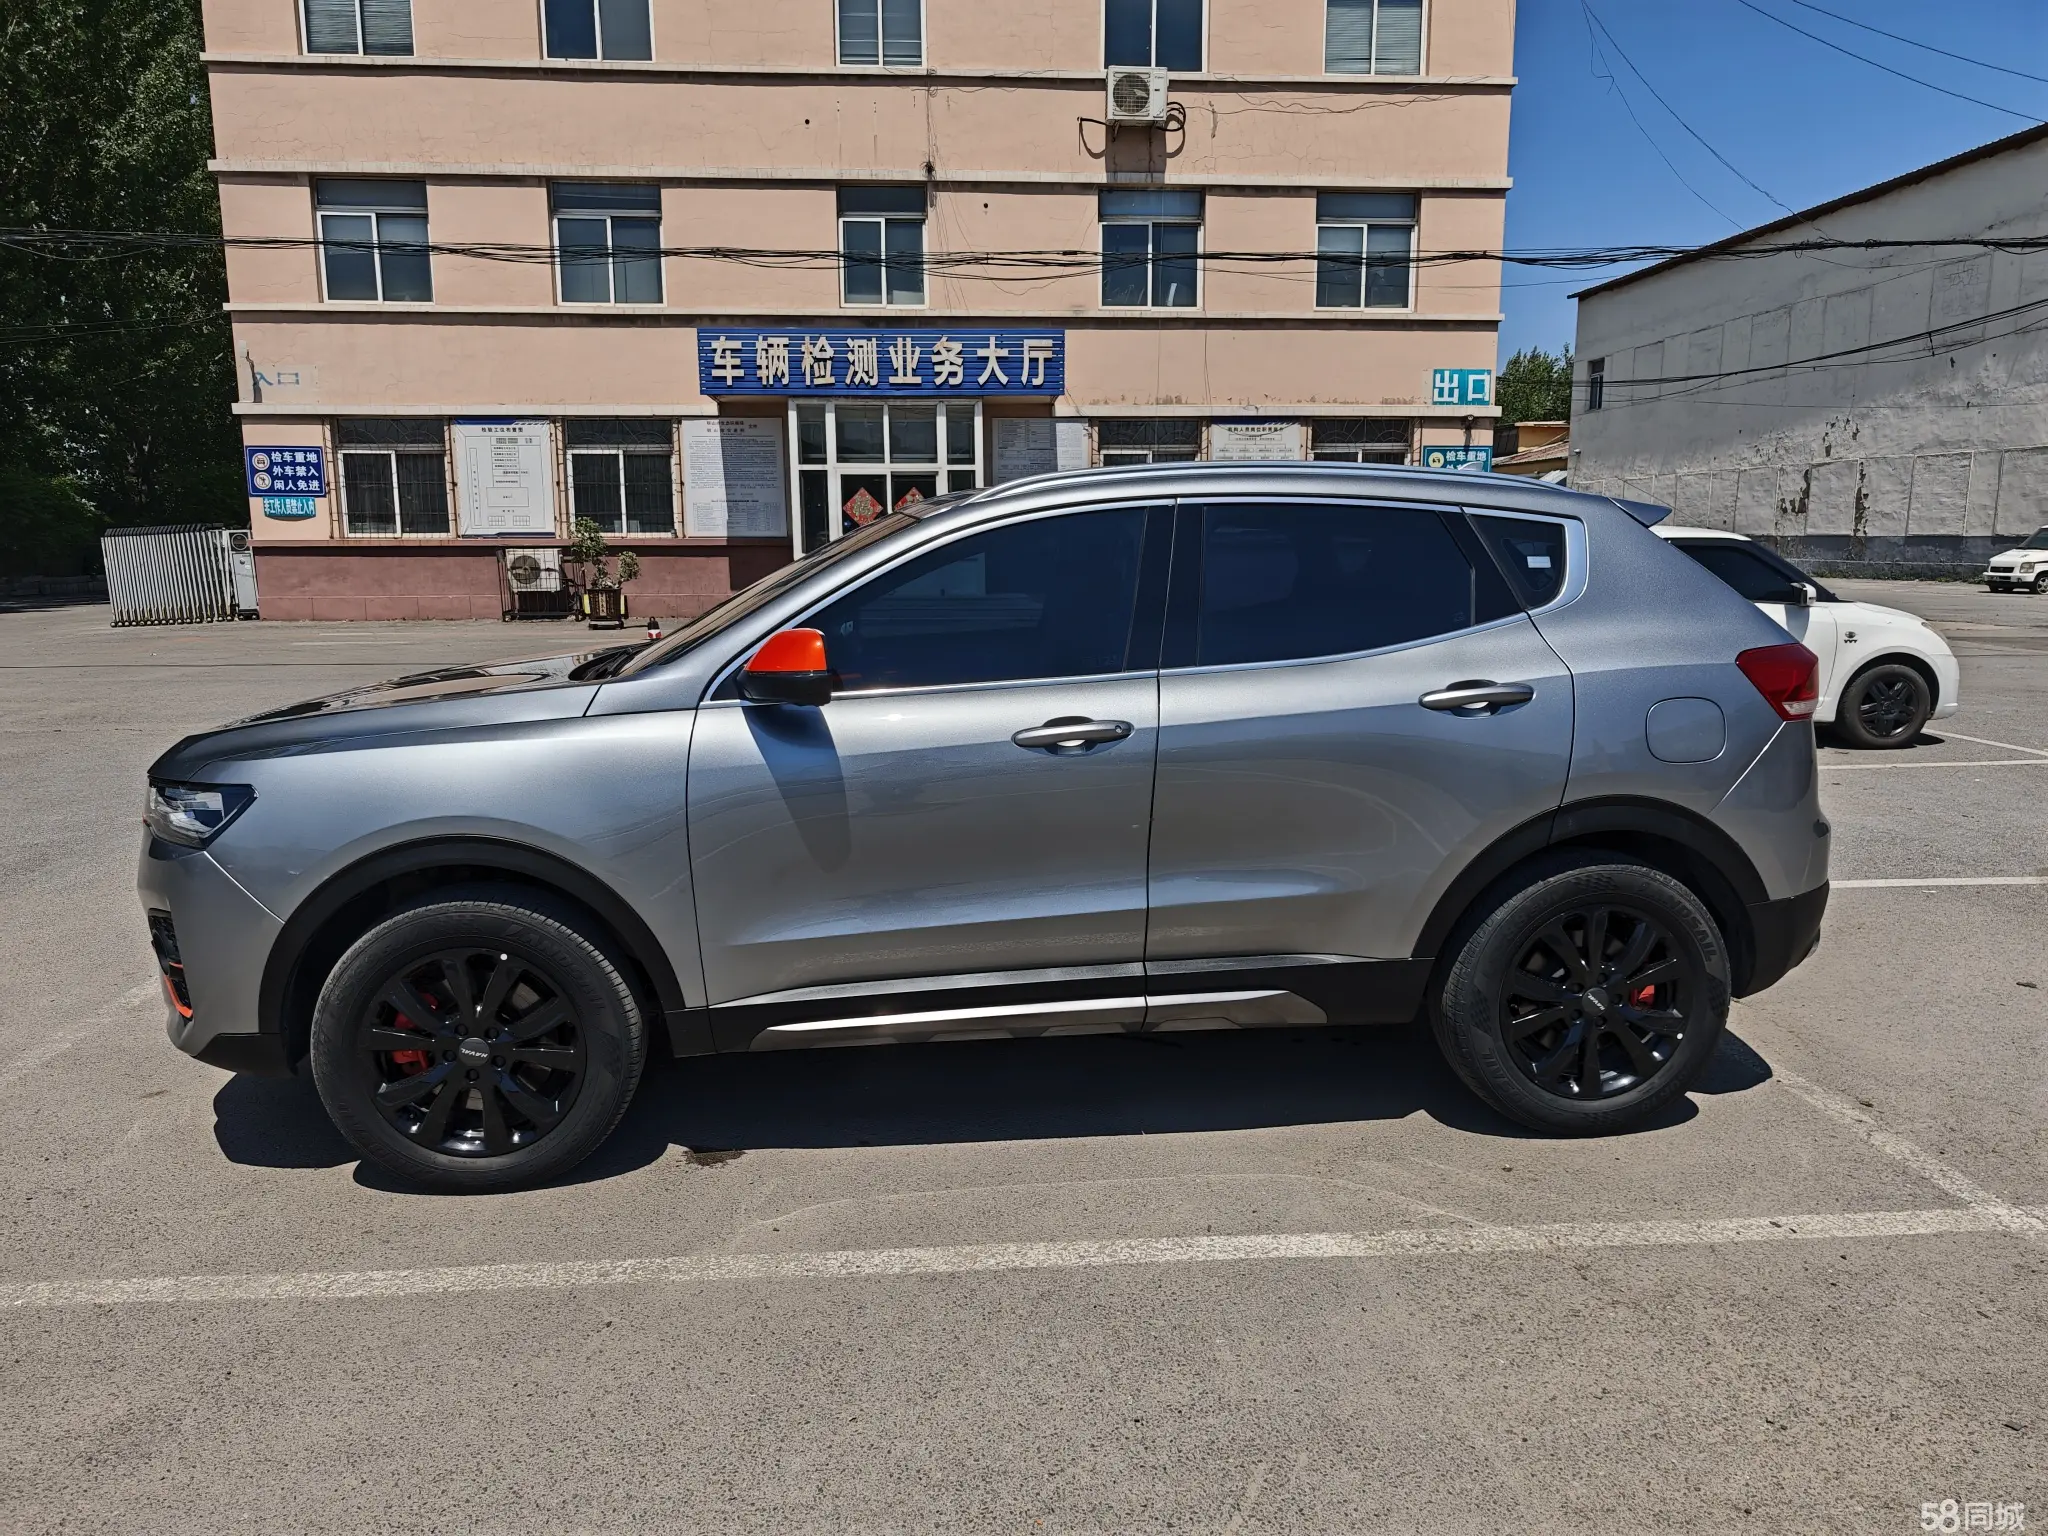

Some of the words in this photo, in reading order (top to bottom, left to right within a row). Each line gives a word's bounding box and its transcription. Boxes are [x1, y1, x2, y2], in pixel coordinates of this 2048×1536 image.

[711, 335, 1054, 387] 车辆检测业务大厅
[1433, 370, 1490, 403] 出口
[271, 451, 319, 464] 检车重地
[1446, 450, 1487, 462] 检车重地
[272, 465, 320, 477] 外车禁入
[274, 480, 321, 491] 闲人免进
[263, 498, 316, 516] 非工作人员禁止入内
[460, 1047, 489, 1058] HAVAL
